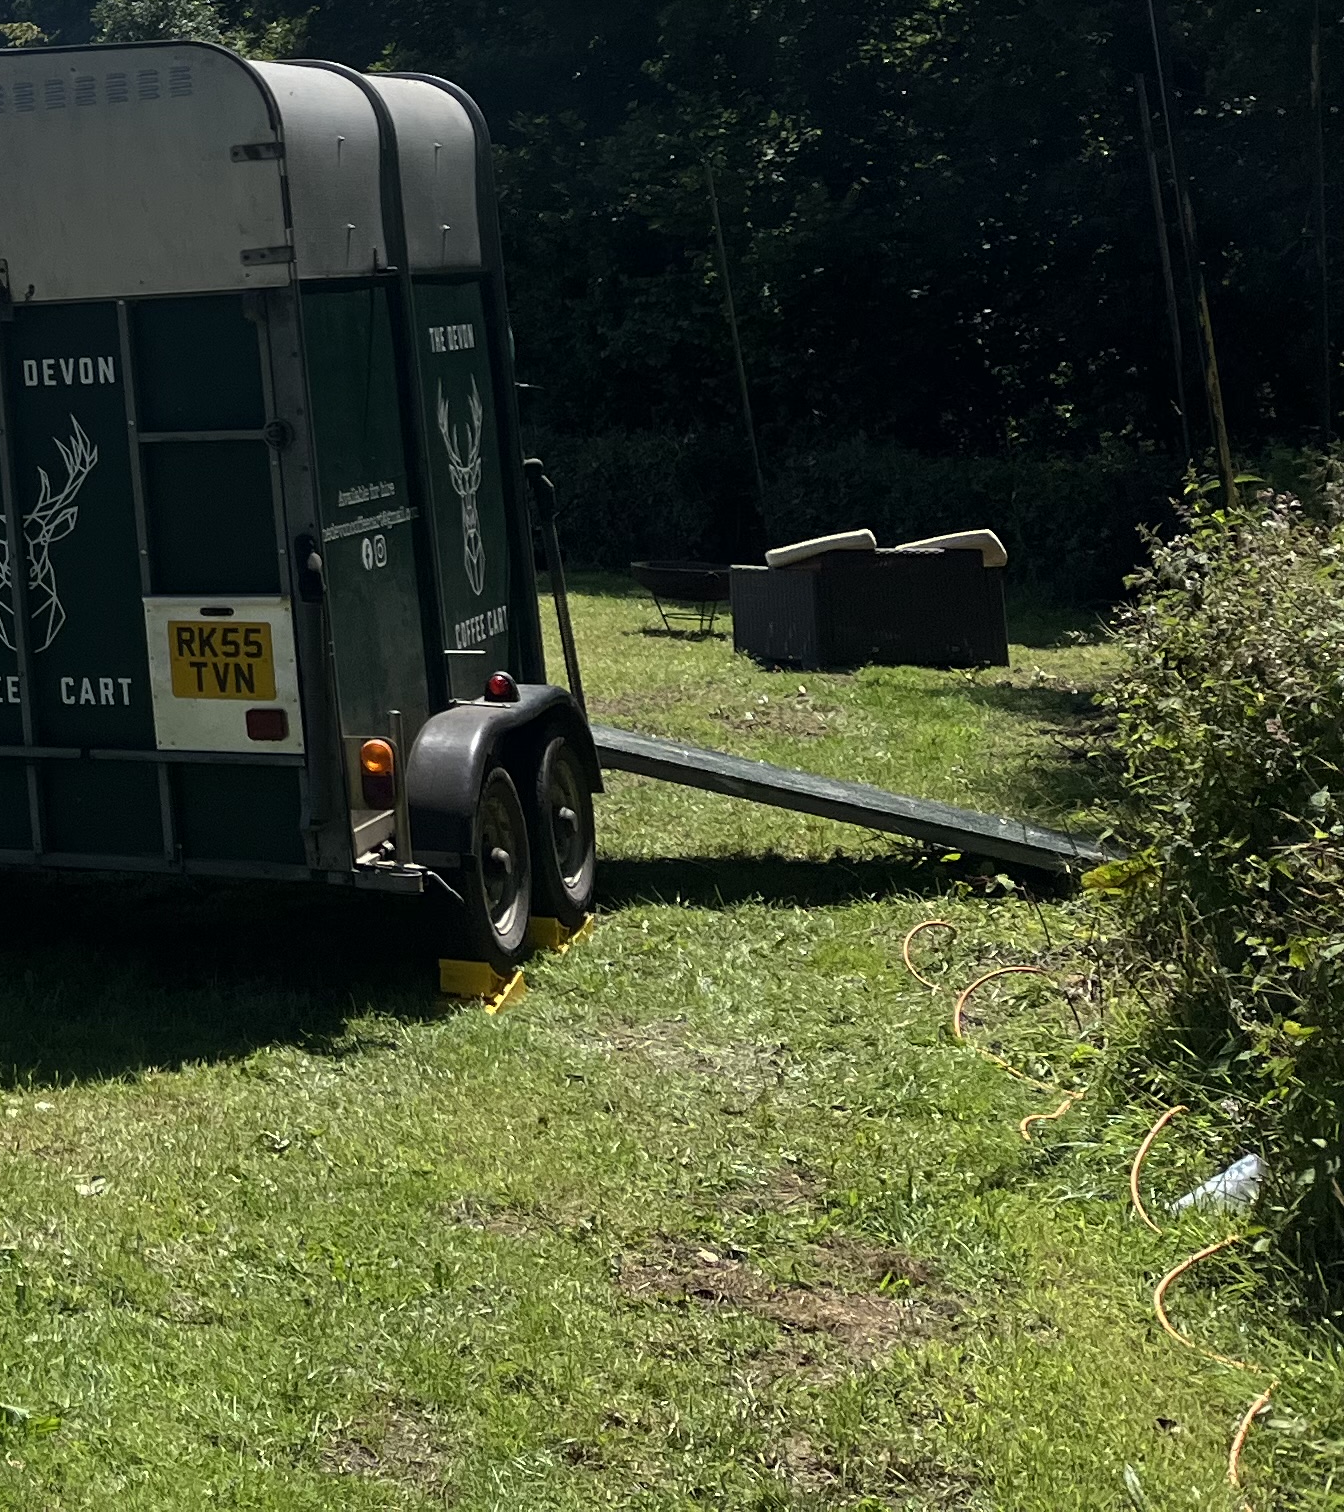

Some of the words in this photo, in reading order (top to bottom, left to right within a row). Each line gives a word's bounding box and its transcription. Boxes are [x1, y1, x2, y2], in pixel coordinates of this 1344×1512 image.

[429, 327, 447, 353] THE
[447, 324, 475, 350] DEVON
[23, 356, 116, 386] DEVON
[455, 614, 487, 649] COFFEE
[487, 605, 508, 636] CART
[177, 627, 263, 658] RK55
[61, 677, 132, 705] CART
[190, 662, 255, 693] TVN
